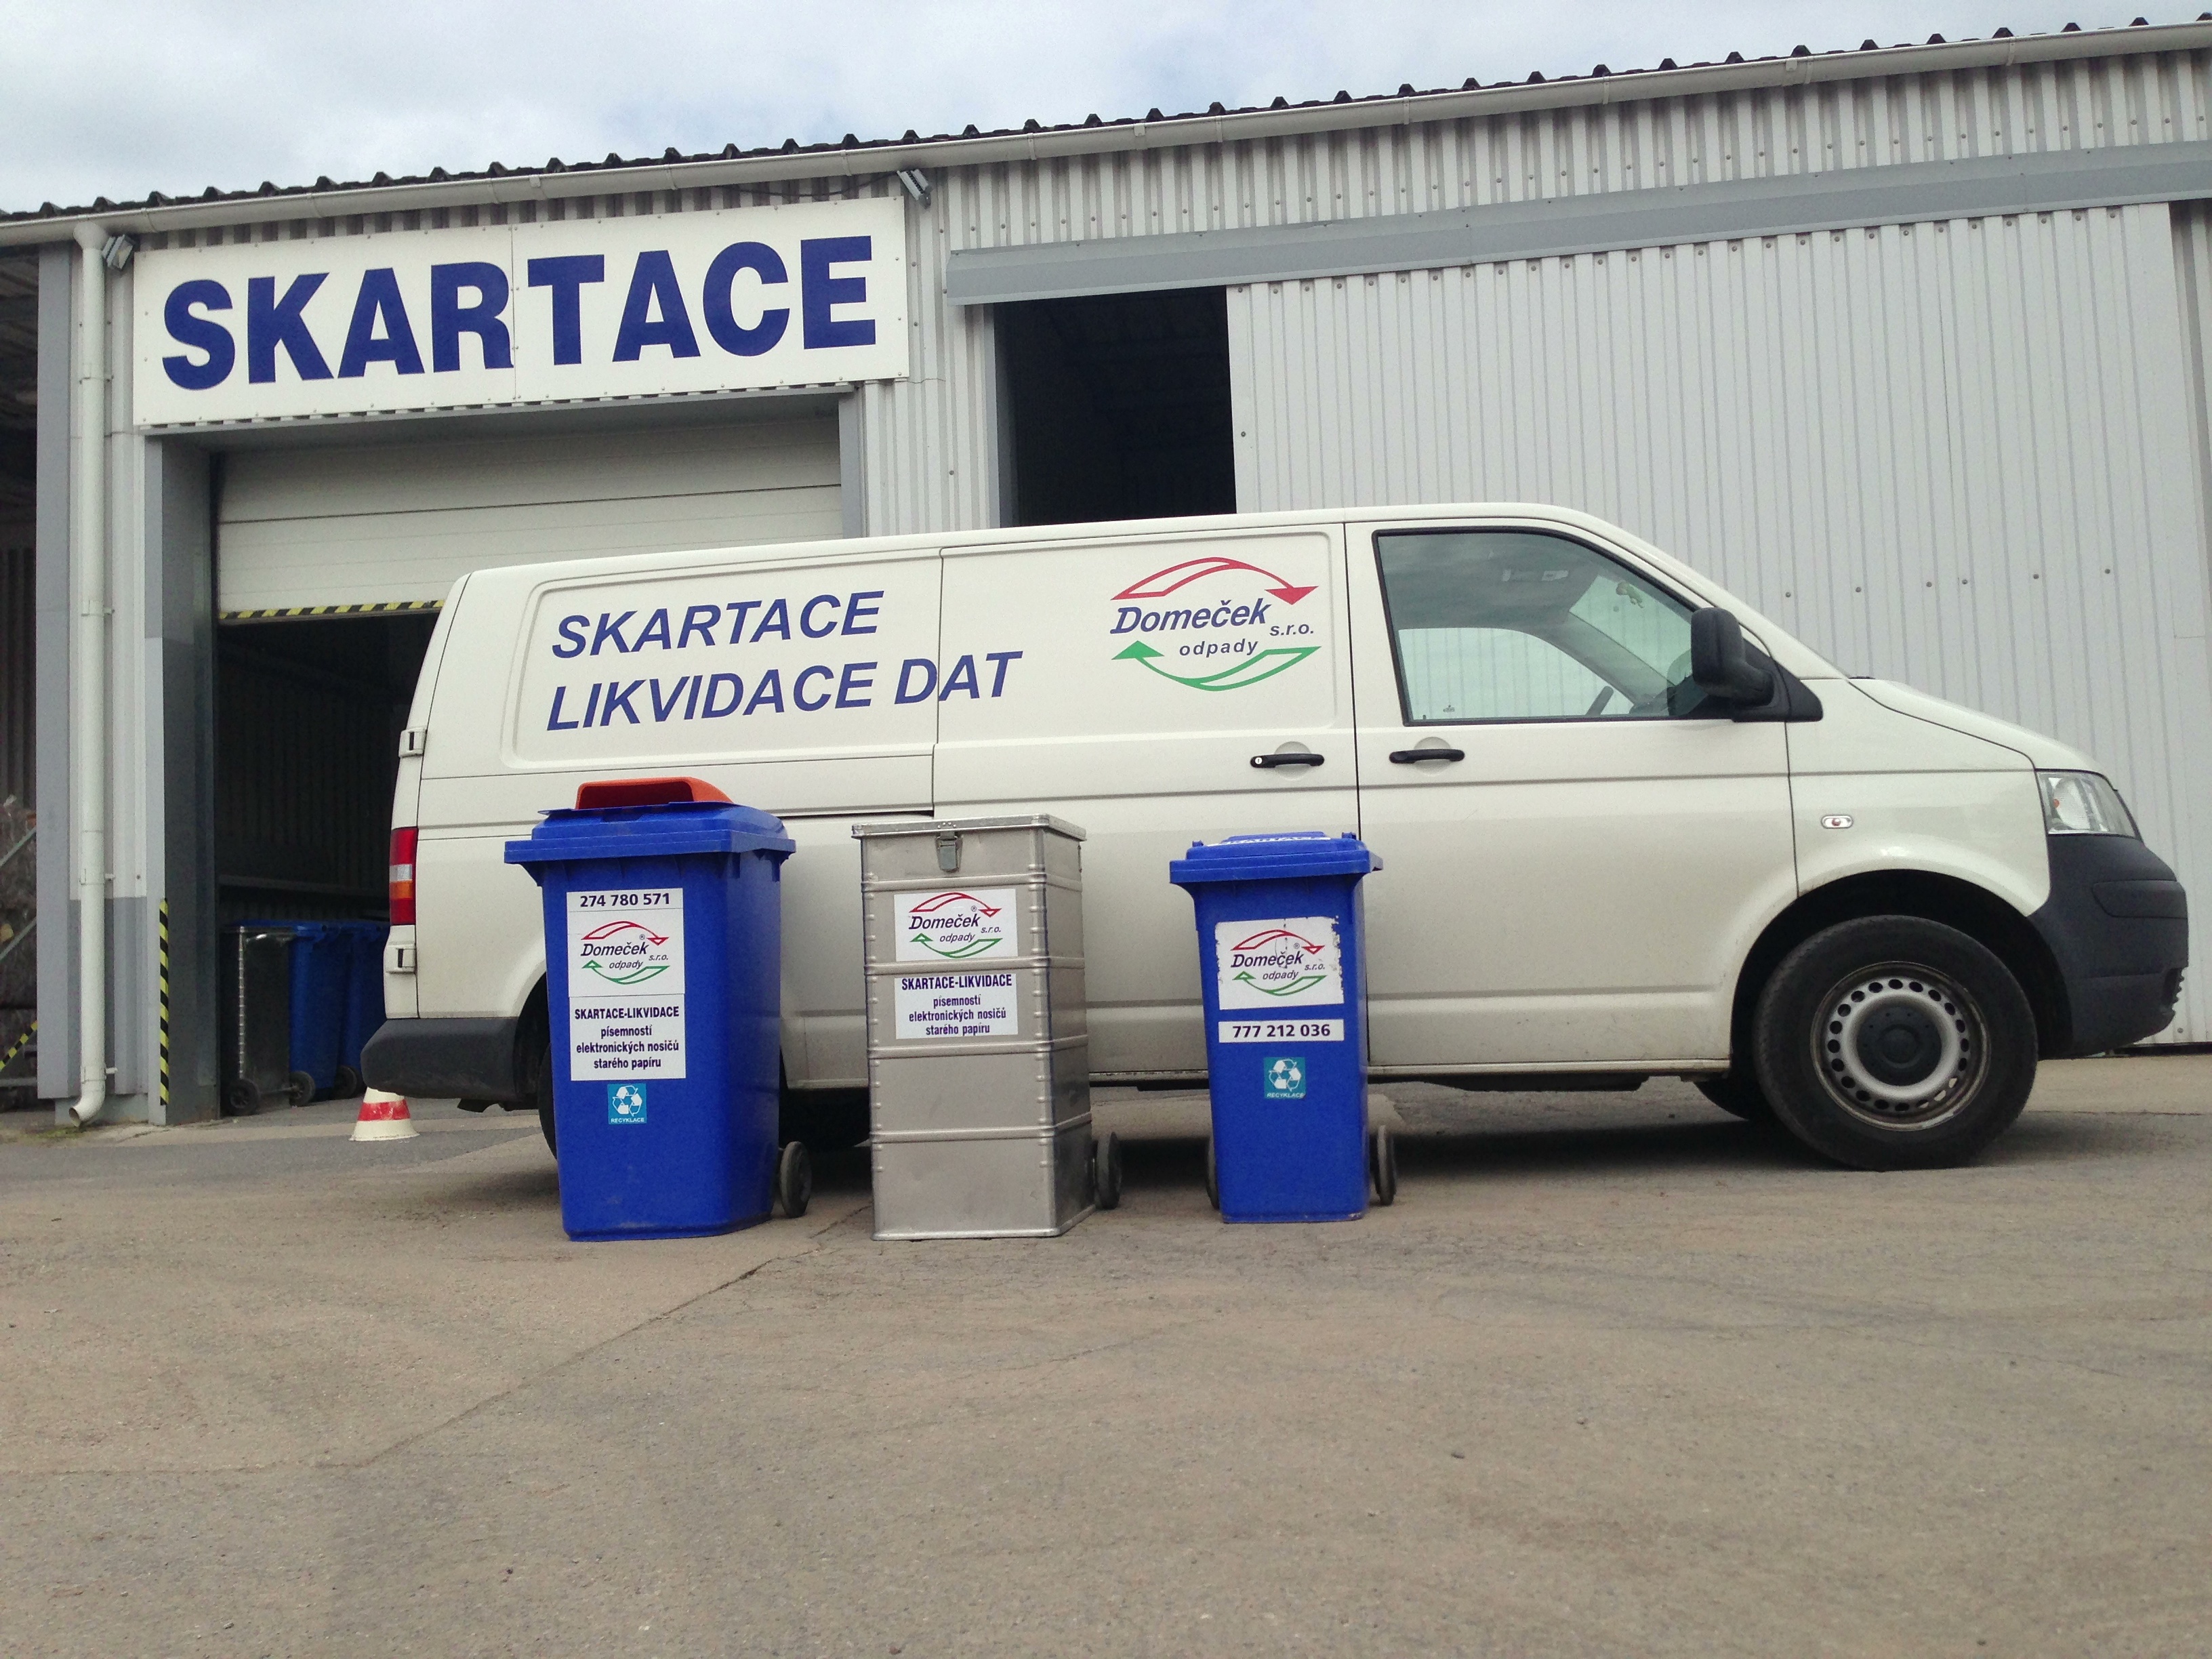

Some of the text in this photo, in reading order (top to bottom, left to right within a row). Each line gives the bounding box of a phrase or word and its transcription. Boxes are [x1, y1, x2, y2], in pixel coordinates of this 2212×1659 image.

[163, 235, 876, 390] SKARTACE
[1109, 598, 1272, 634] Domeček
[552, 590, 884, 659] SKARTACE
[1269, 622, 1314, 636] s.r.o.
[1179, 638, 1258, 657] odpady
[546, 651, 1023, 731] LIKVIDACE DAT
[580, 893, 670, 907] 274 780 571
[908, 914, 981, 929] Domeček
[939, 933, 976, 943] odpady
[580, 941, 649, 956] Domeček
[609, 960, 643, 970] odpady
[1230, 951, 1304, 968] Domeček
[901, 974, 1012, 990] SKARTACE-LIKVIDACE
[1263, 970, 1298, 980] odpady
[575, 1006, 680, 1019] SKARTACE-LIKVIDACE
[909, 1009, 974, 1022] elektronických
[600, 1025, 653, 1039] písemností
[926, 1022, 990, 1036] starého papíru
[1232, 1024, 1330, 1038] 777 212 036
[576, 1041, 644, 1054] elektronických
[594, 1057, 661, 1070] starého papíru
